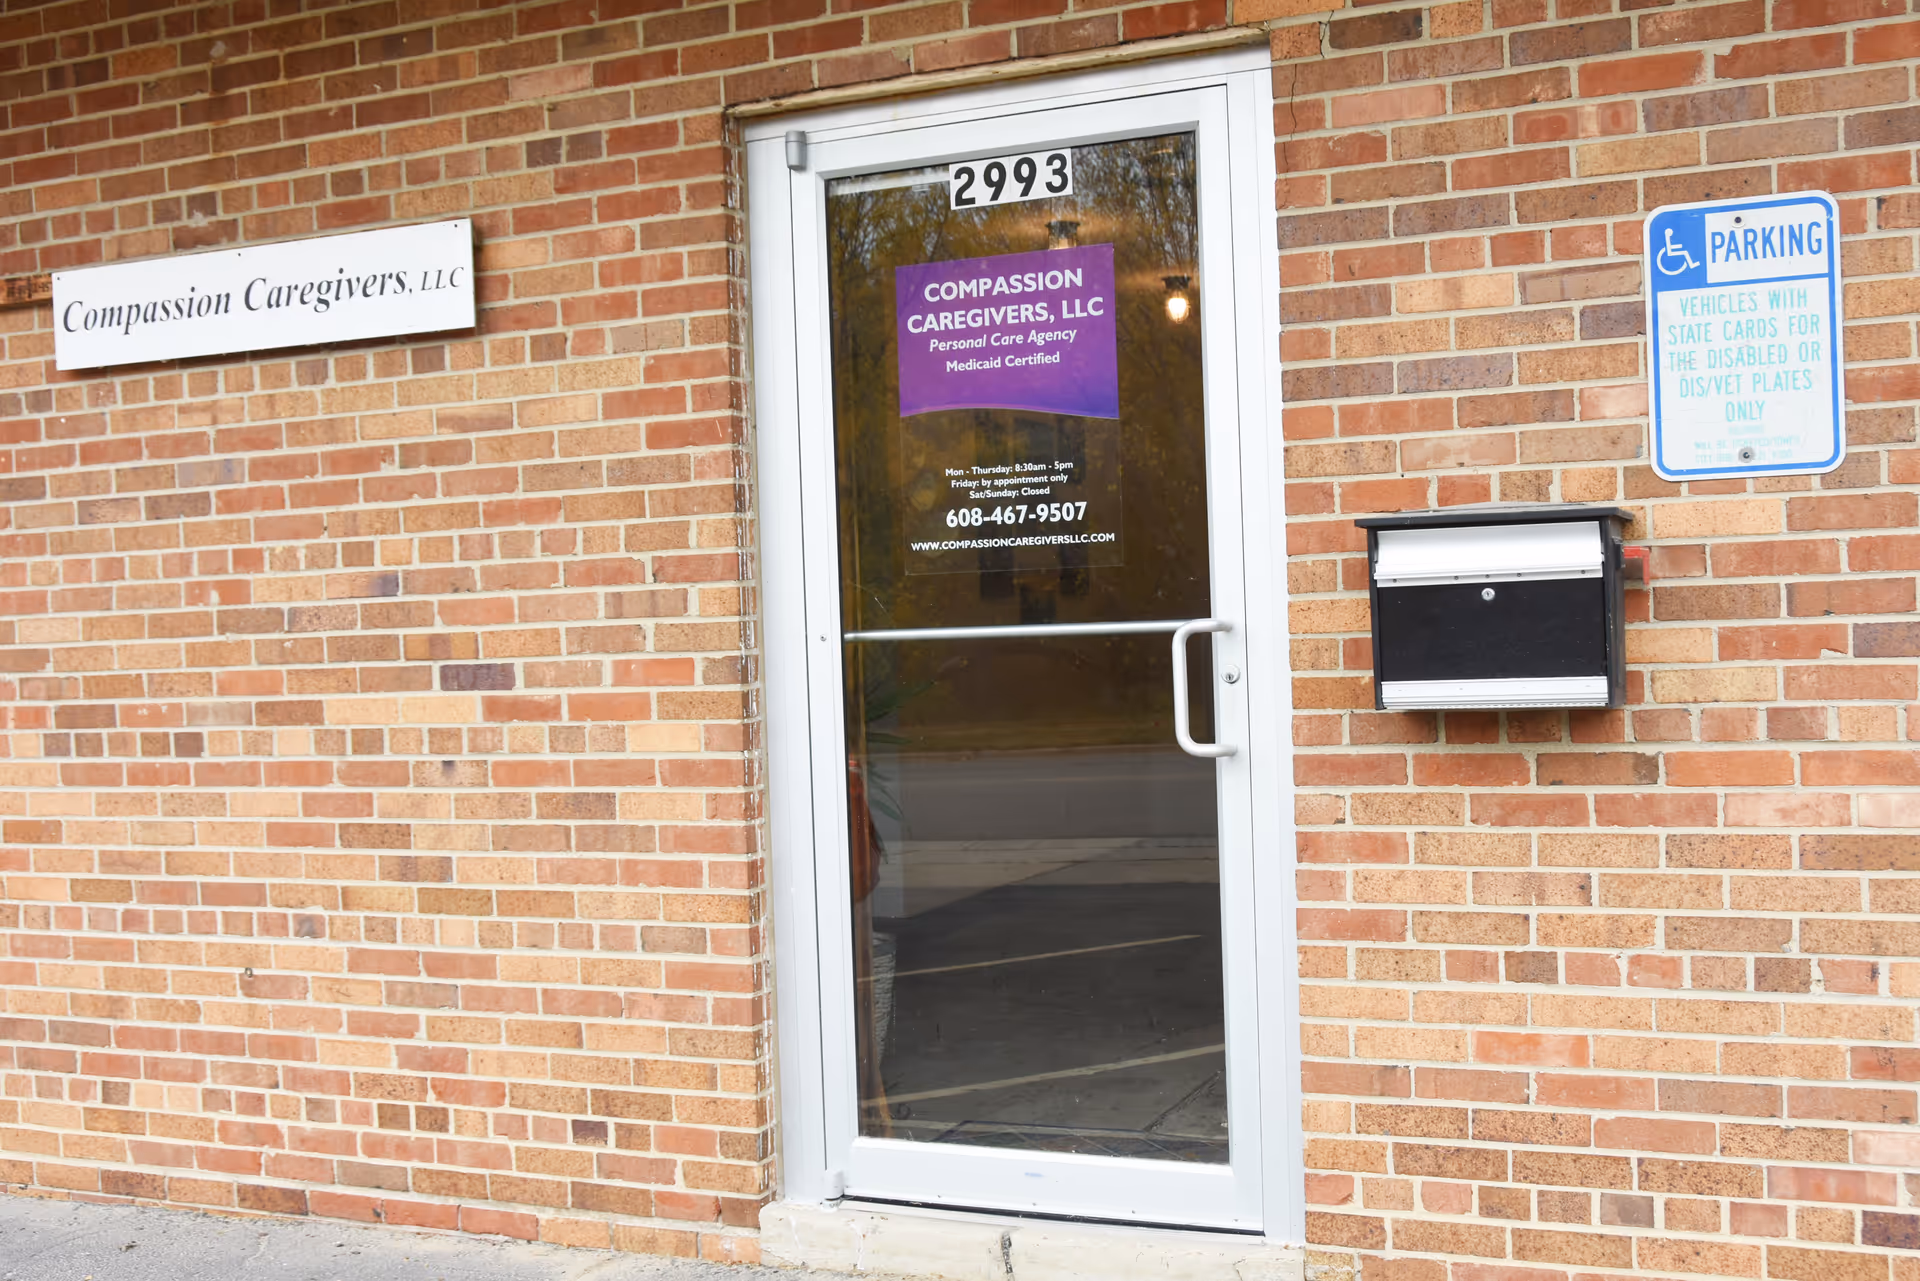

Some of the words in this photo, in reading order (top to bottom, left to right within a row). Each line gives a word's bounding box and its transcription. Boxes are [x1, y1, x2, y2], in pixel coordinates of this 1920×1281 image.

[954, 153, 1069, 207] 2993
[1711, 221, 1823, 264] PARKING
[924, 268, 1083, 302] COMPASSION
[62, 286, 232, 335] Compassion
[243, 267, 414, 313] Caregivers,
[420, 266, 465, 292] LLC
[907, 302, 1055, 333] CAREGIVERS,
[1062, 297, 1104, 319] LLC
[1679, 291, 1758, 317] VEHICLES
[1768, 288, 1808, 310] WITH
[929, 334, 987, 352] Personal
[990, 331, 1024, 347] Care
[1027, 328, 1077, 346] Agency
[1668, 322, 1713, 346] STATE
[1723, 317, 1778, 341] CARDS
[1788, 314, 1820, 336] FOR
[946, 356, 1001, 373] Medicaid
[1004, 351, 1060, 368] Certified
[1668, 351, 1697, 372] THE
[1707, 343, 1788, 369] DISABLED
[1798, 341, 1821, 363] OR
[1679, 374, 1742, 398] DIS/VET
[1752, 369, 1813, 393] PLATES
[1725, 401, 1765, 422] ONLY
[945, 468, 964, 477] Mon
[971, 465, 1013, 476] Thursday:
[1014, 462, 1046, 472] 8:30am
[1054, 461, 1074, 471] 5pm
[951, 479, 980, 489] Friday:
[981, 477, 992, 488] by
[993, 475, 1049, 487] appointment
[1050, 473, 1069, 483] only
[969, 488, 1019, 499] Sat/Sunday:
[1021, 487, 1050, 496] Closed
[946, 501, 1087, 528] 608-467-9507
[911, 533, 1116, 551] WWW.COMPASSIONCAREGIVERSLLC.COM
